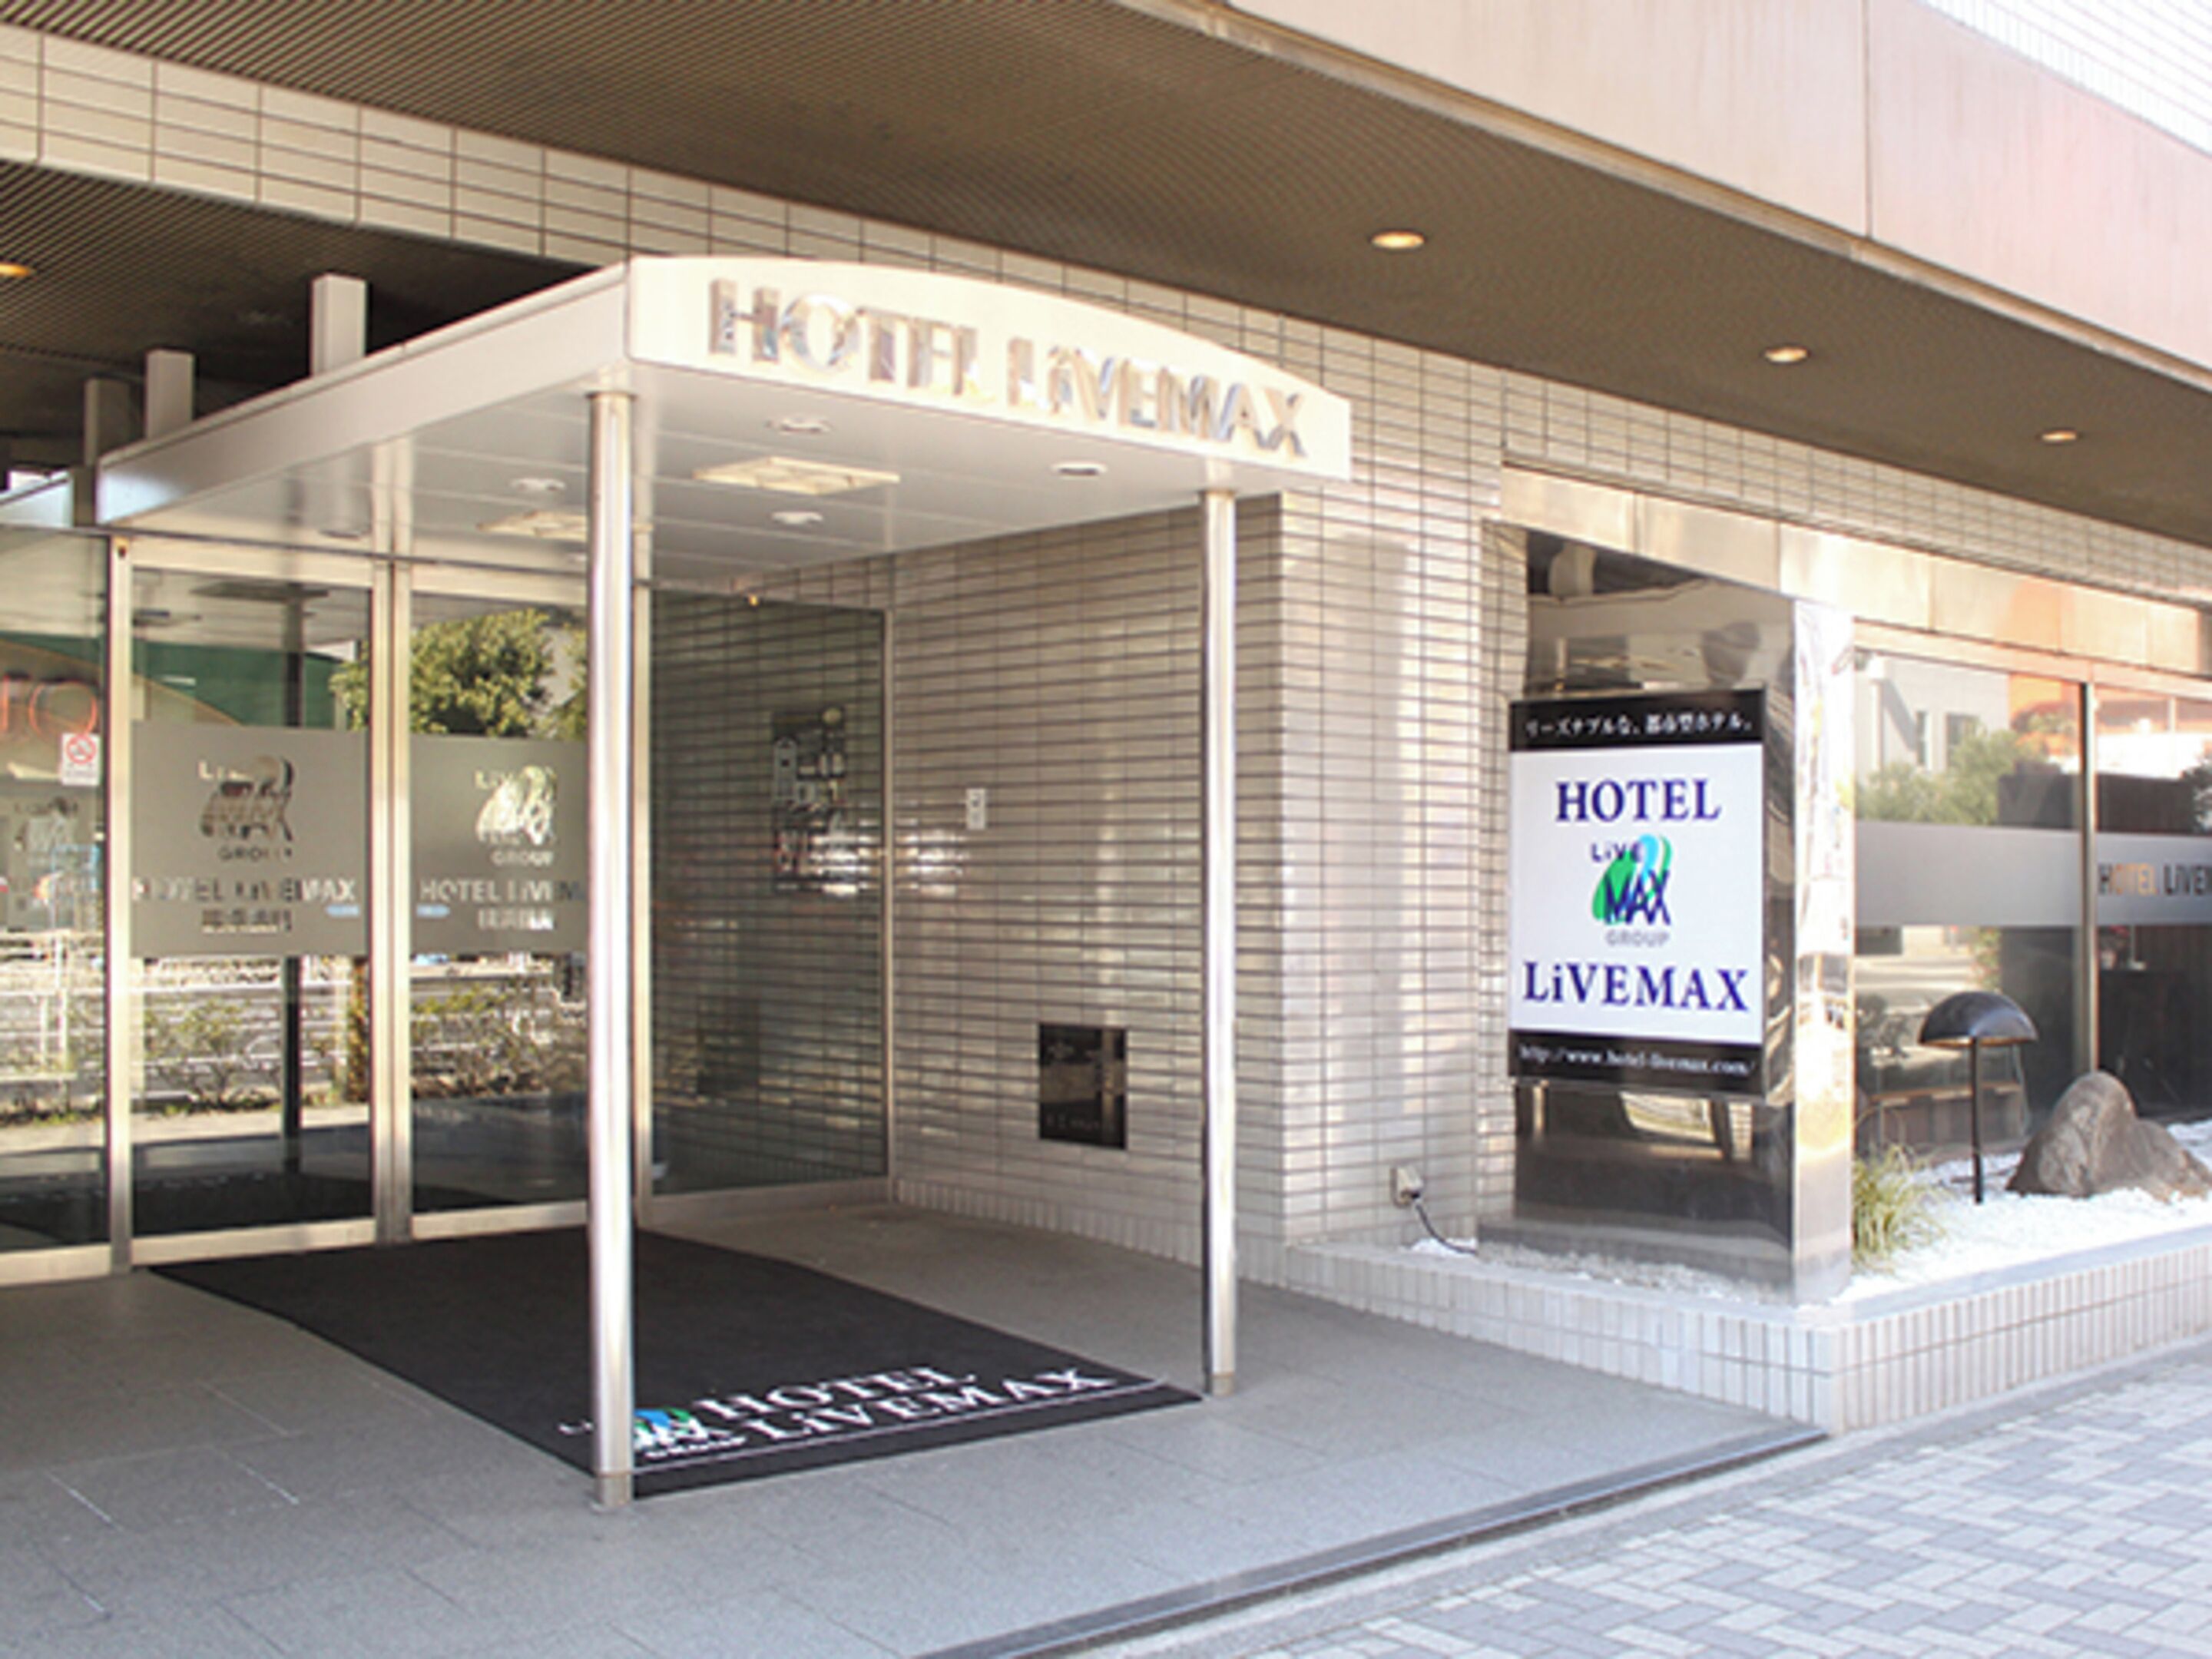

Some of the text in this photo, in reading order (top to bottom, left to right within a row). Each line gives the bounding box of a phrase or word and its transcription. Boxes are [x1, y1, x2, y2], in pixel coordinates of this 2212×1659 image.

[708, 278, 1307, 459] HOTEL LiVEMAX
[1555, 778, 1721, 823] HOTEL
[419, 880, 499, 902] HOTEL
[1604, 868, 1671, 926] MAX
[2098, 863, 2160, 896] HOTEL
[1605, 929, 1670, 947] GROUP
[1523, 961, 1749, 1012] LiVEMAX
[695, 1366, 976, 1420] HOTEL
[743, 1367, 1117, 1441] LiVEMAX
